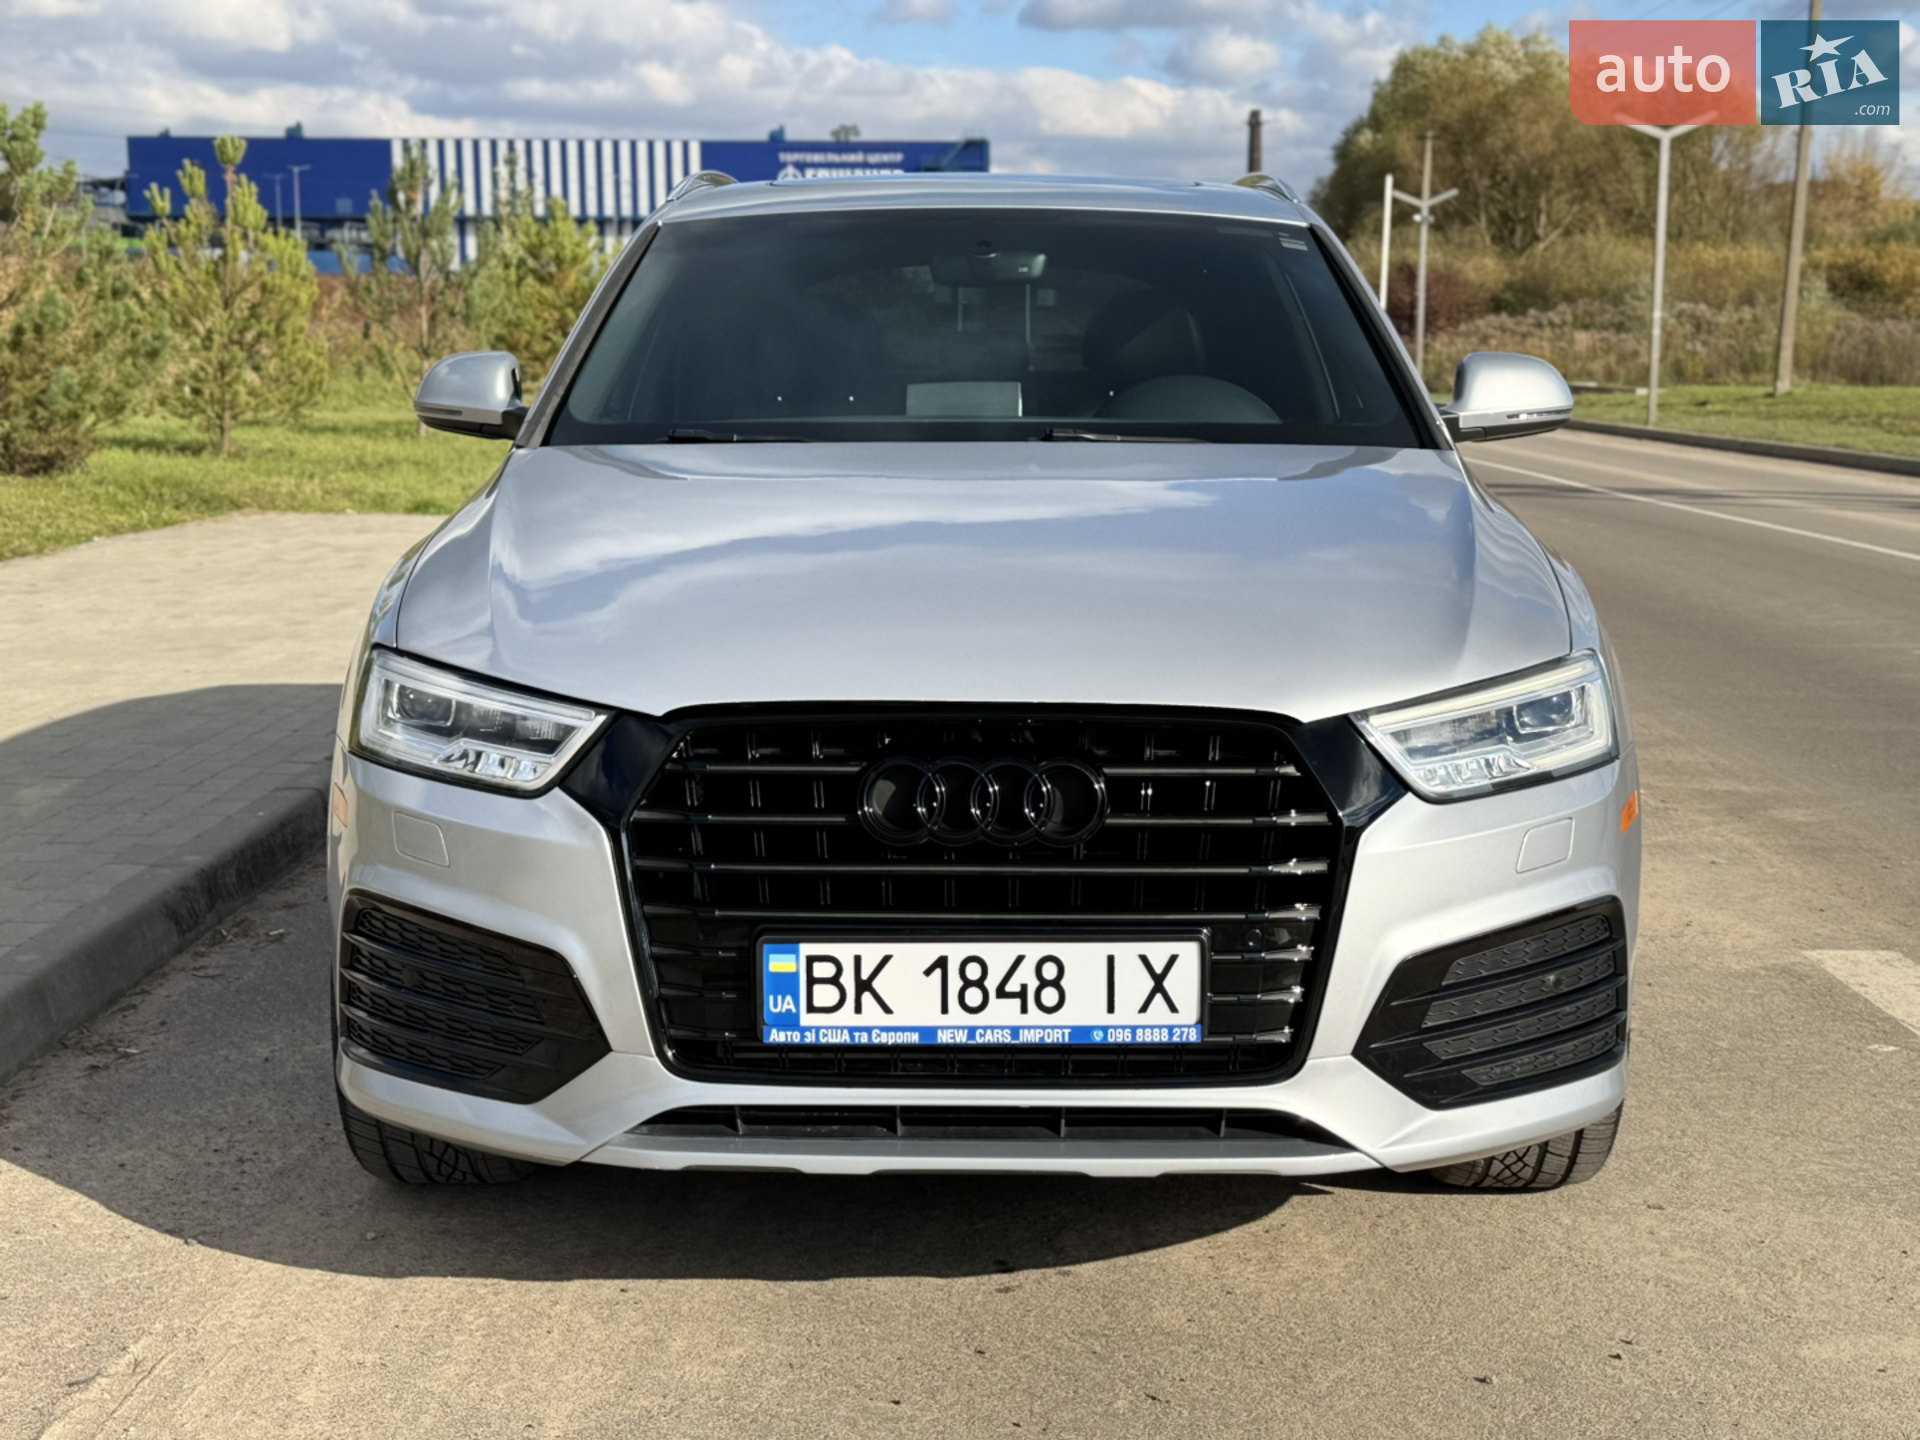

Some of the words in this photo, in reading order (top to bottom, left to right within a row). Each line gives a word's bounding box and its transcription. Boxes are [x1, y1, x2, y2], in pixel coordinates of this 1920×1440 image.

[805, 954, 894, 1014] BK
[922, 954, 1066, 1015] 1848
[1106, 954, 1180, 1014] IX
[769, 994, 796, 1013] UA
[769, 1028, 800, 1043] Авто
[803, 1028, 816, 1043] зі
[819, 1028, 850, 1043] США
[853, 1030, 868, 1043] та
[871, 1029, 919, 1045] Європи
[1107, 1028, 1132, 1043] 096
[1135, 1028, 1169, 1043] 8888
[1172, 1027, 1198, 1043] 278
